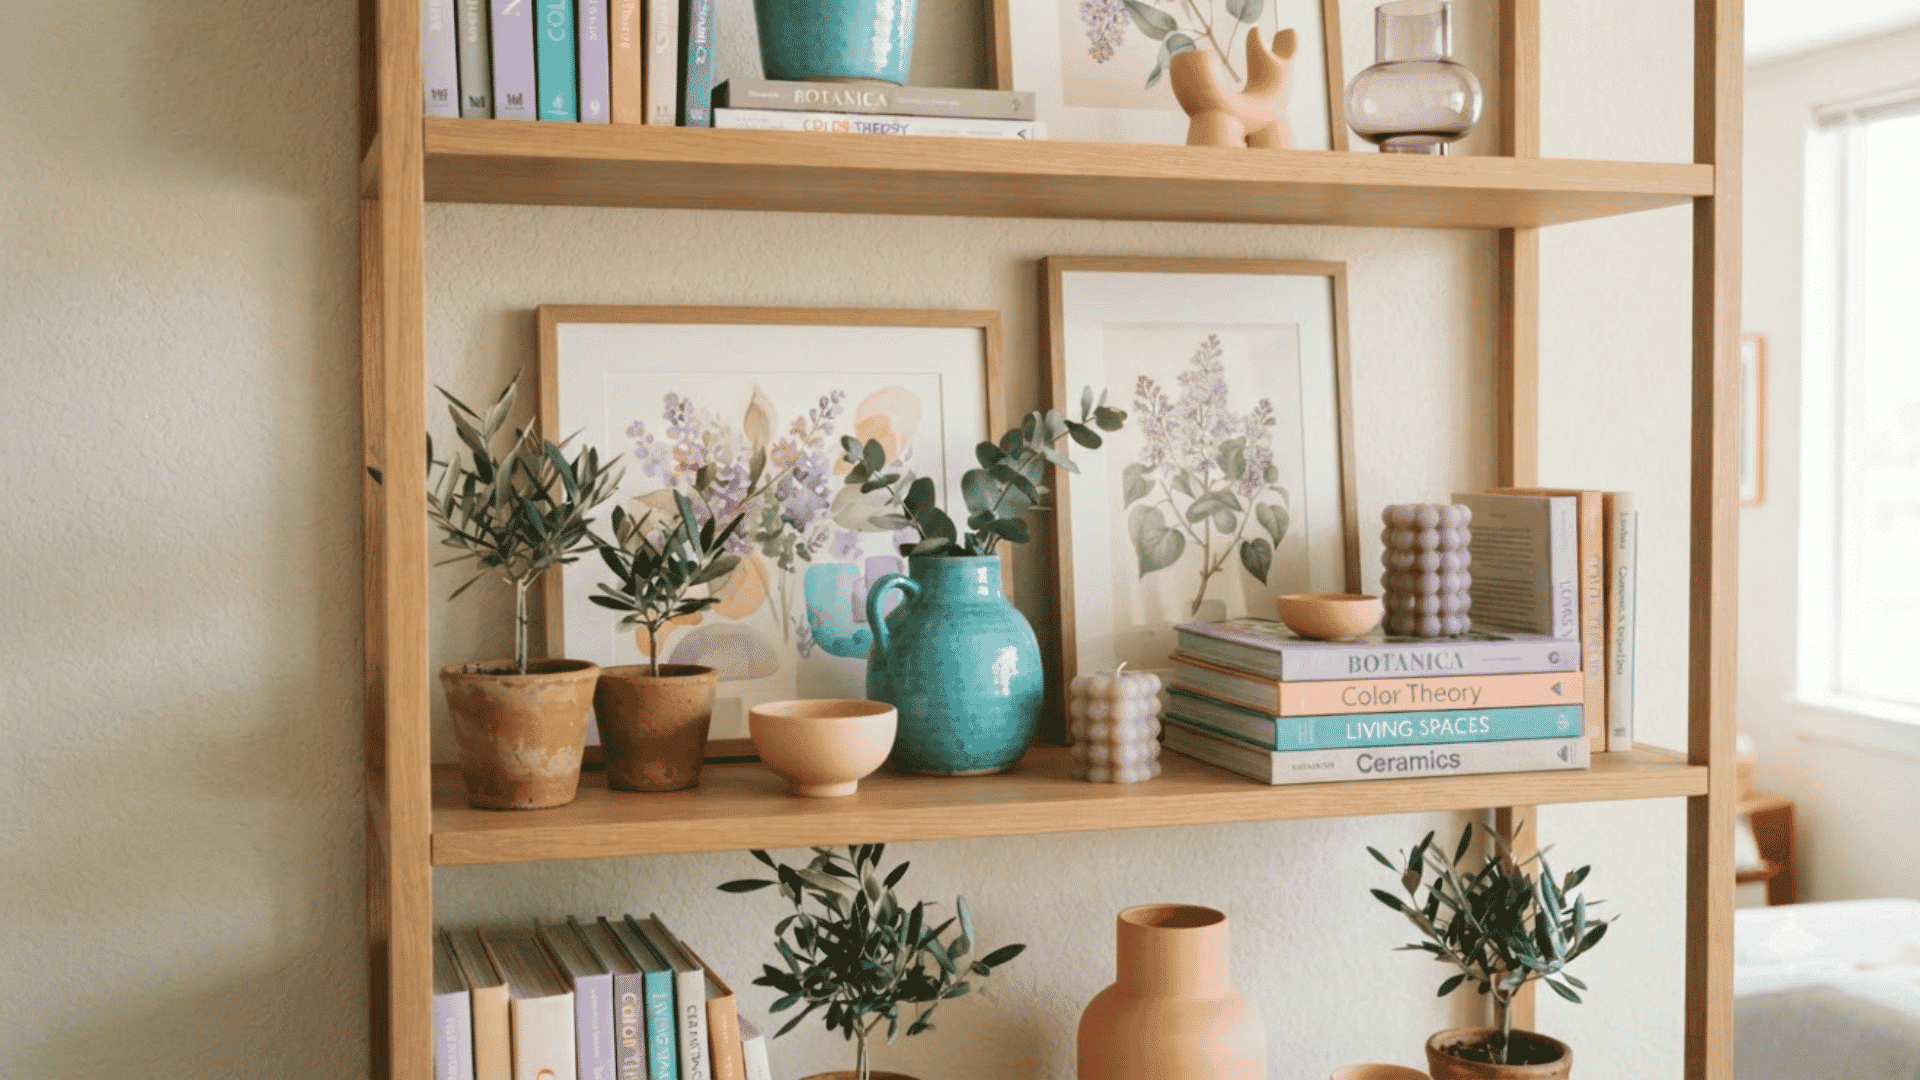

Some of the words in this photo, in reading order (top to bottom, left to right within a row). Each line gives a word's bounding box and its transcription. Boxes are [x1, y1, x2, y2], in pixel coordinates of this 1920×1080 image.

[1347, 652, 1464, 674] BOTANICA
[1341, 685, 1401, 706] Color
[1405, 682, 1482, 705] Theory
[1346, 719, 1413, 740] LIVING
[1419, 715, 1490, 736] SPACES
[1356, 750, 1461, 774] Ceramics
